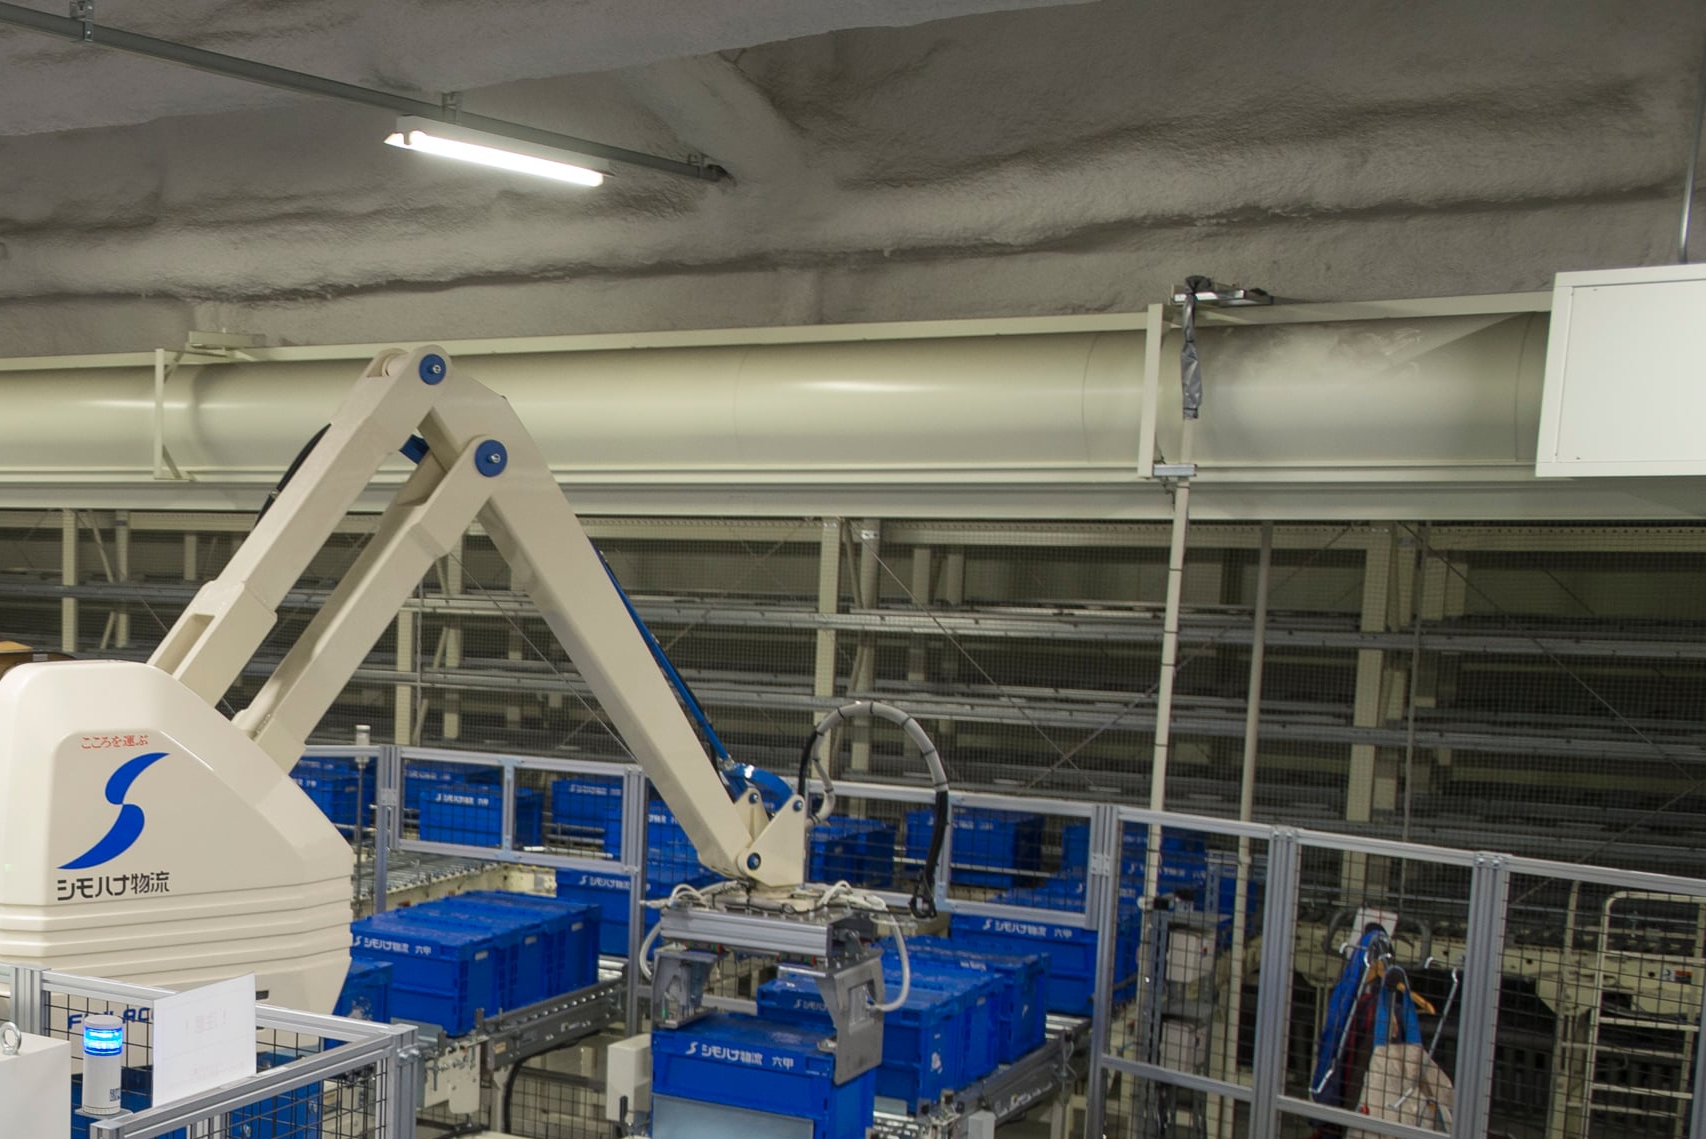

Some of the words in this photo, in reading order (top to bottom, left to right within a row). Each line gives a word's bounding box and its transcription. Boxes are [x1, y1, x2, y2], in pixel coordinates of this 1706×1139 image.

[81, 735, 149, 749] こころを運ぶ
[57, 871, 170, 901] シモハナ物流
[122, 1007, 154, 1024] AC
